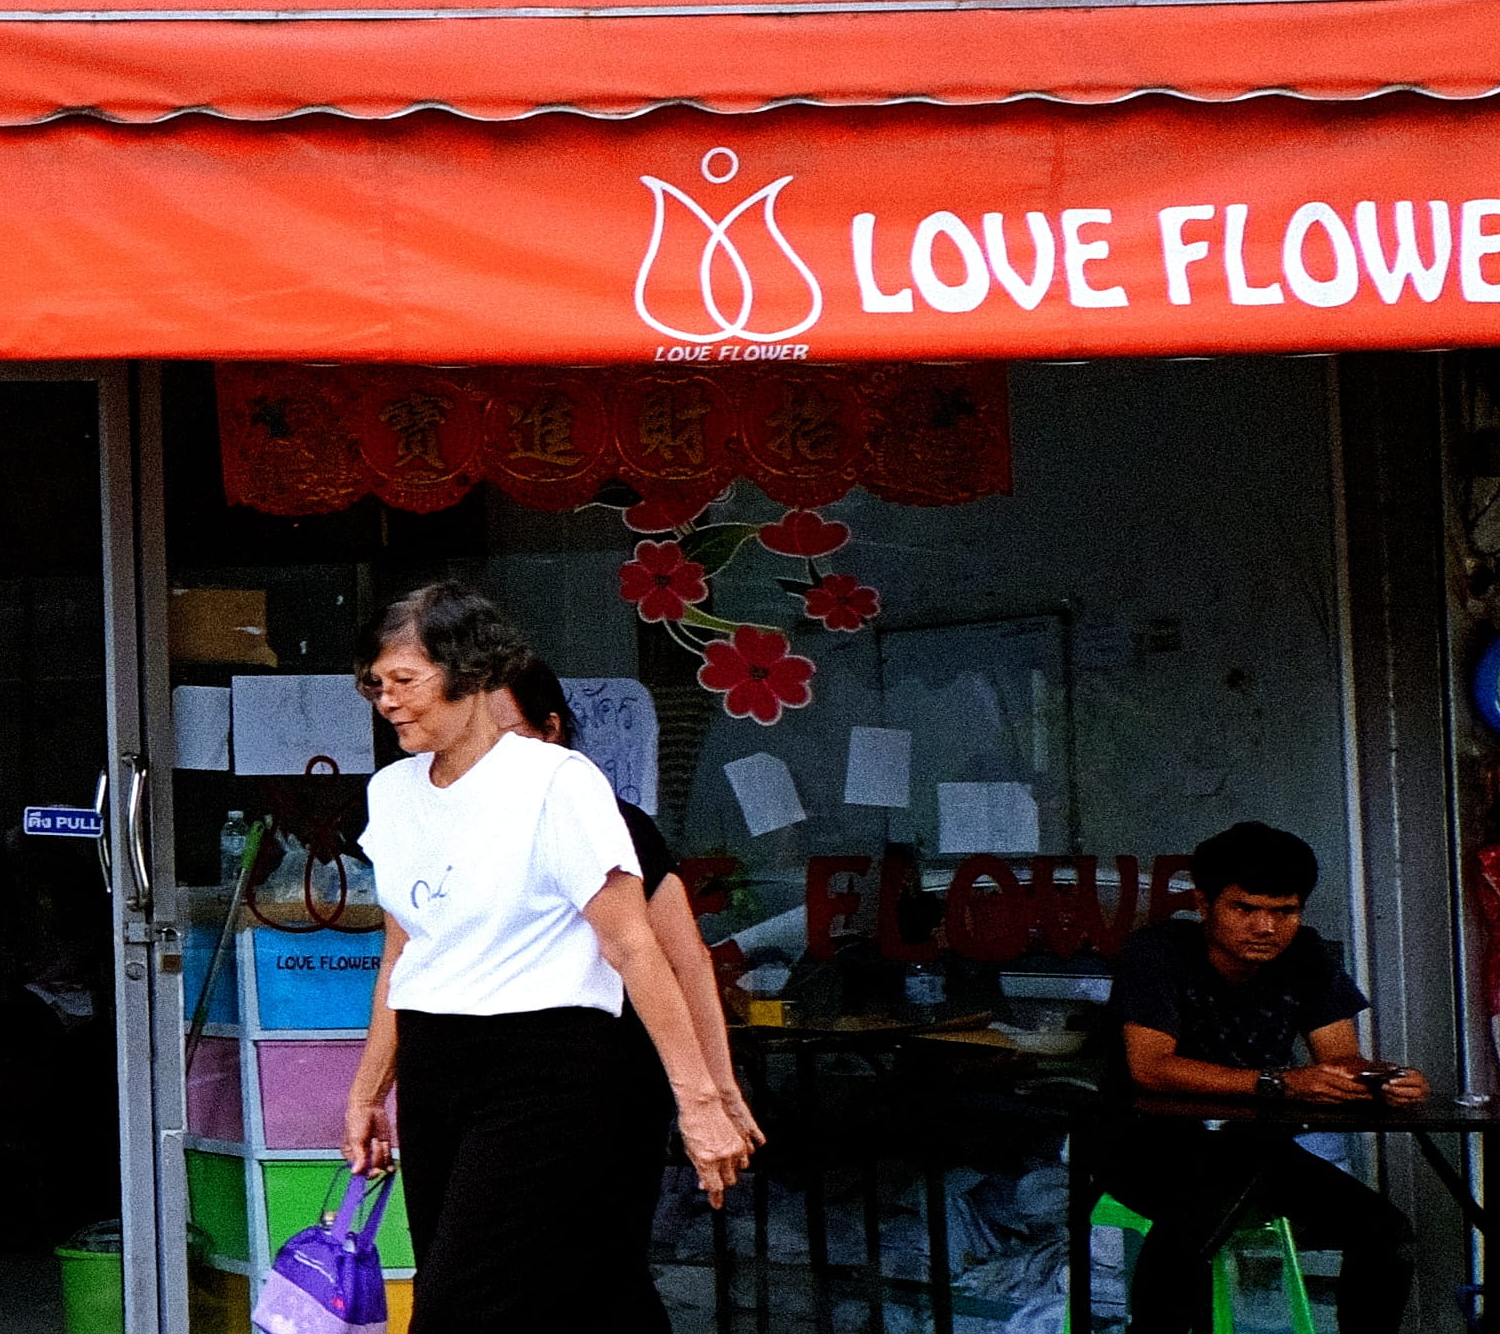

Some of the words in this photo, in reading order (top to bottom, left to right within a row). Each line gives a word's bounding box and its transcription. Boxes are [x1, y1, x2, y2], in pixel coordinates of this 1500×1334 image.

[850, 208, 1128, 313] LOVE
[654, 346, 711, 362] LOVE
[717, 343, 808, 362] FLOWER
[27, 811, 52, 829] ดึง
[56, 817, 101, 830] PULL
[276, 955, 316, 970] LOVE
[320, 955, 381, 971] FLOWER
